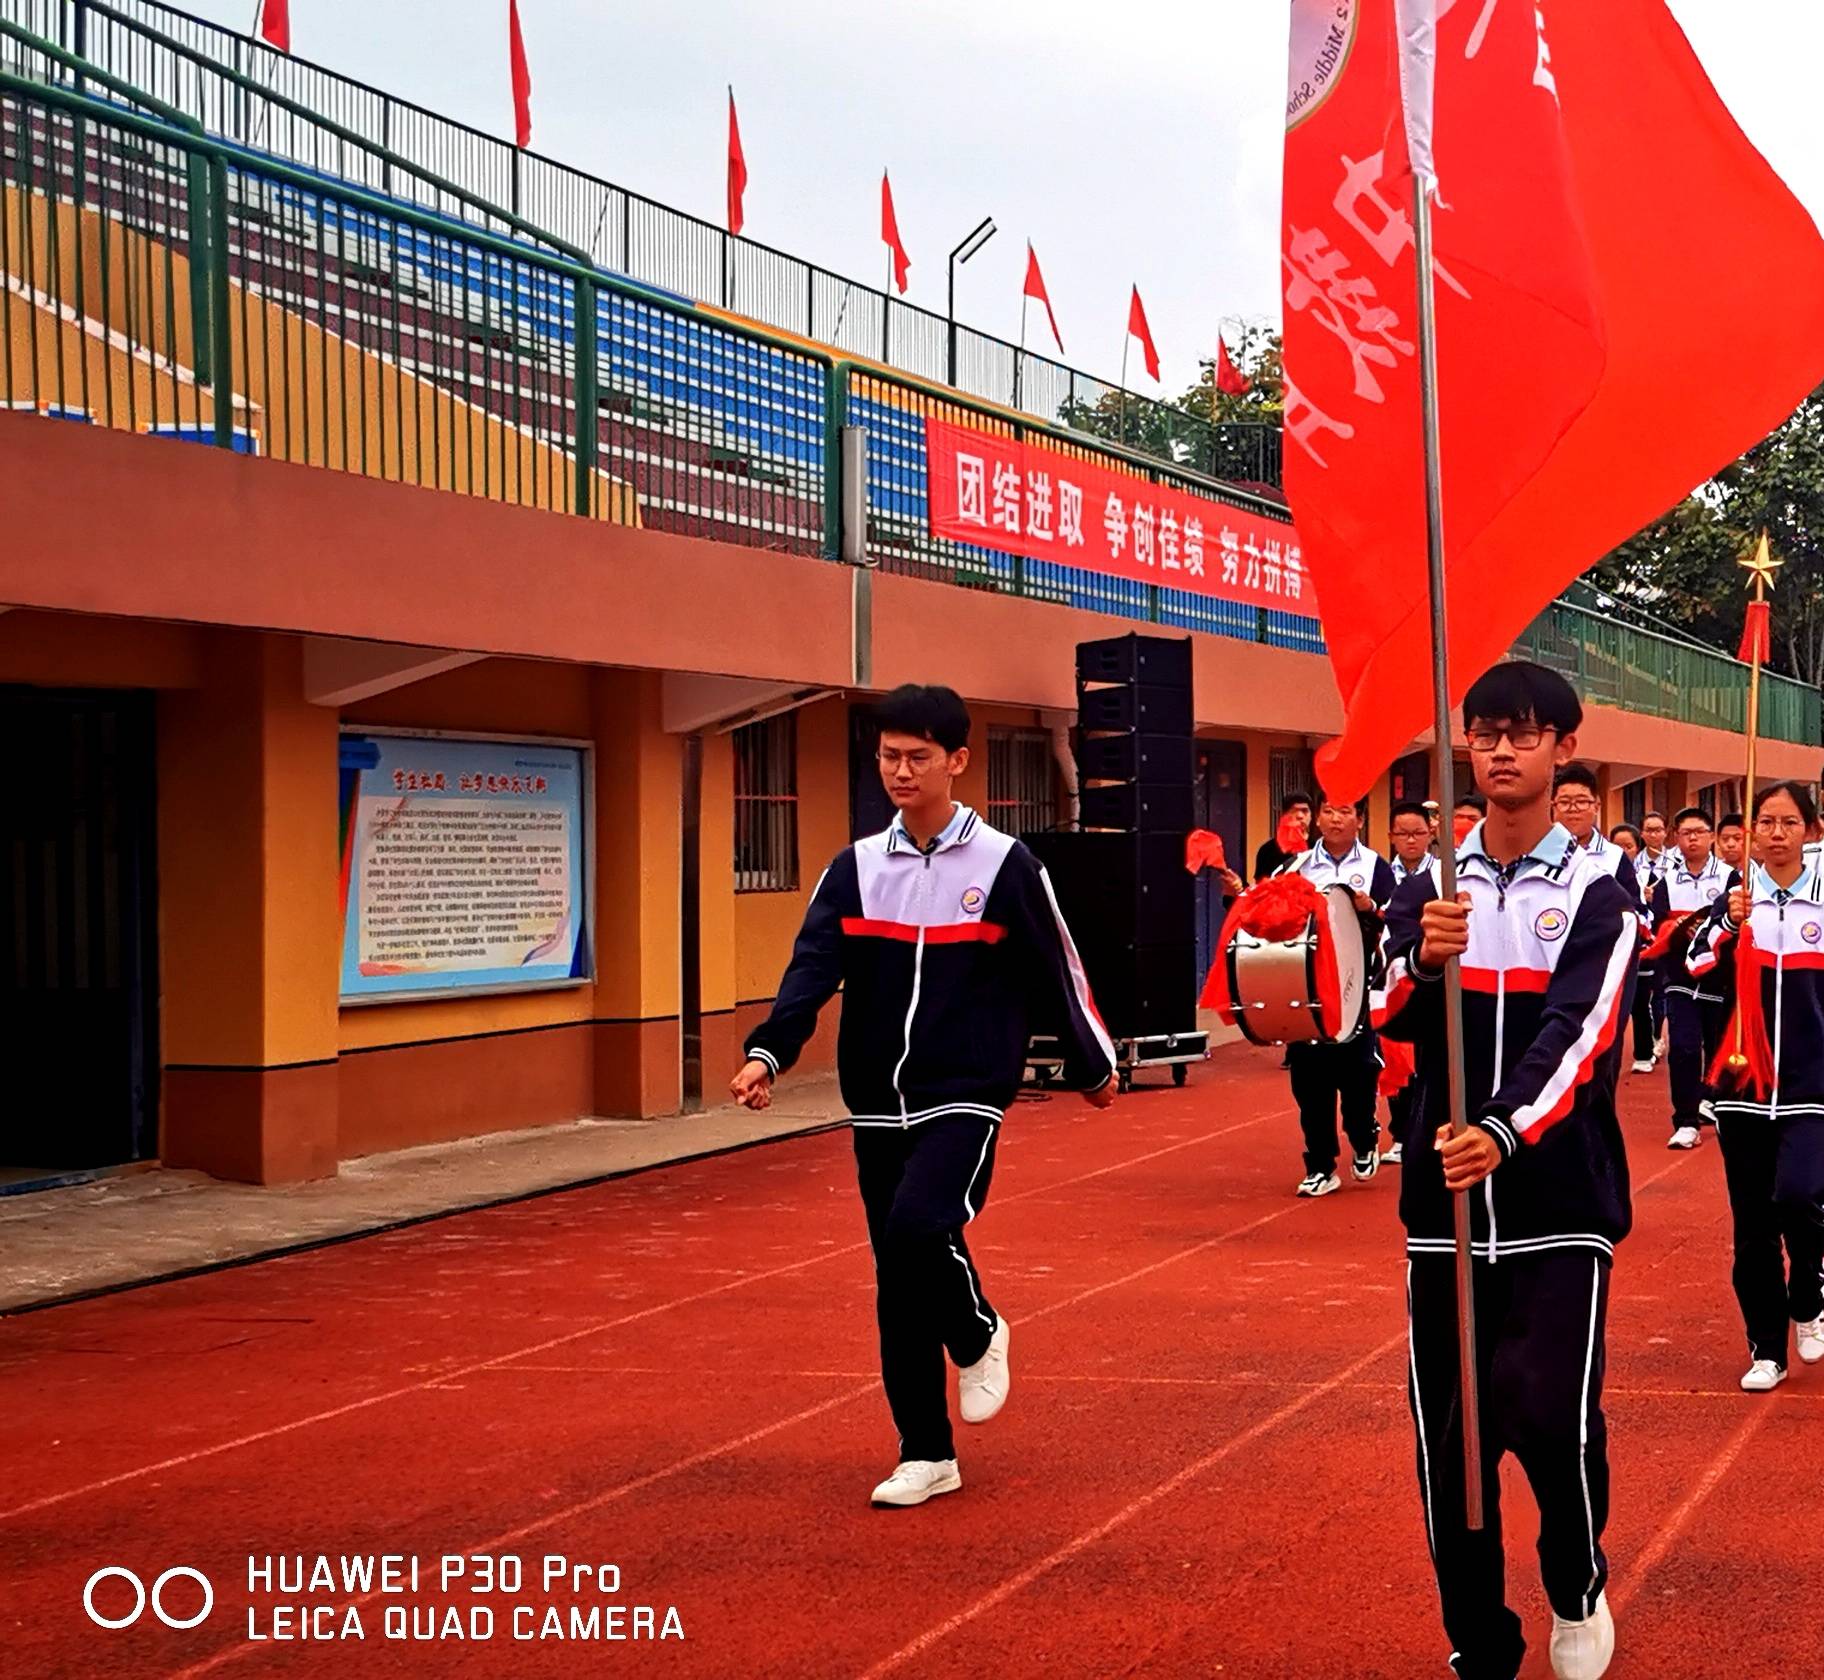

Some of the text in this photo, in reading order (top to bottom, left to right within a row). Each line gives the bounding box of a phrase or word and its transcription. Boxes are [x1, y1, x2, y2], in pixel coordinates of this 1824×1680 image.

[956, 451, 1085, 548] 团结进取
[1104, 491, 1206, 578] 争创佳绩
